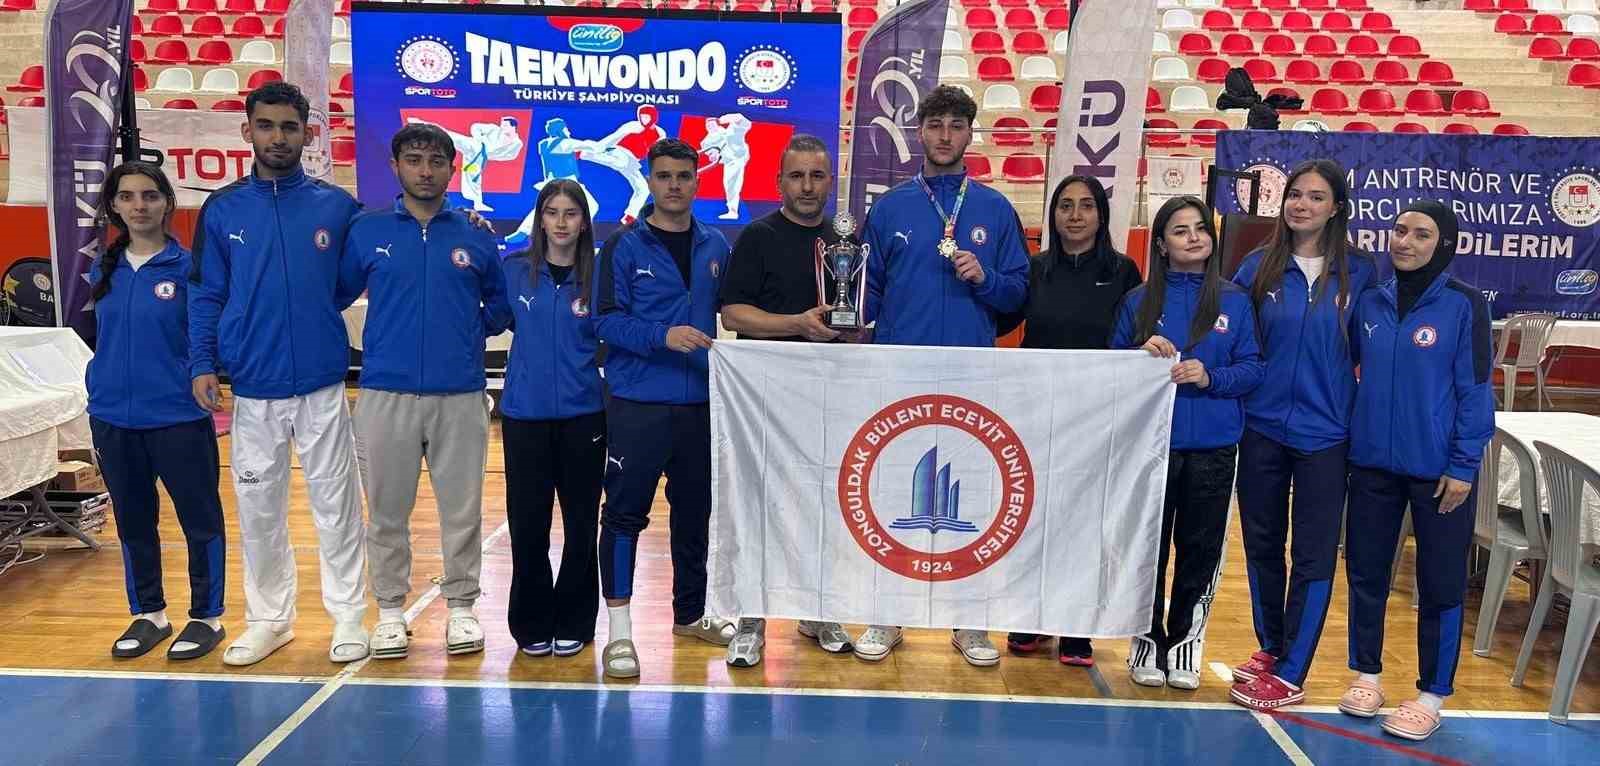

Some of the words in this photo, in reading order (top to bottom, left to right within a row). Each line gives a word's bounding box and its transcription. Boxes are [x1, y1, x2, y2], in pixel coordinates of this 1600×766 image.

[465, 31, 727, 92] TAEKWONDO
[513, 88, 575, 101] TÜRKİYE
[579, 90, 679, 105] ŞAMPİYONASI
[1073, 80, 1125, 199] KÜ
[167, 148, 255, 181] TOT
[1363, 167, 1501, 194] ANTRENÖR
[1509, 173, 1542, 195] VE
[865, 404, 934, 446] BÜLENT
[940, 404, 1006, 443] ECEVİT
[847, 448, 893, 557] ZONGULDAK
[973, 444, 1028, 565] ÜNİVERSİTESİ
[911, 559, 953, 573] 1924
